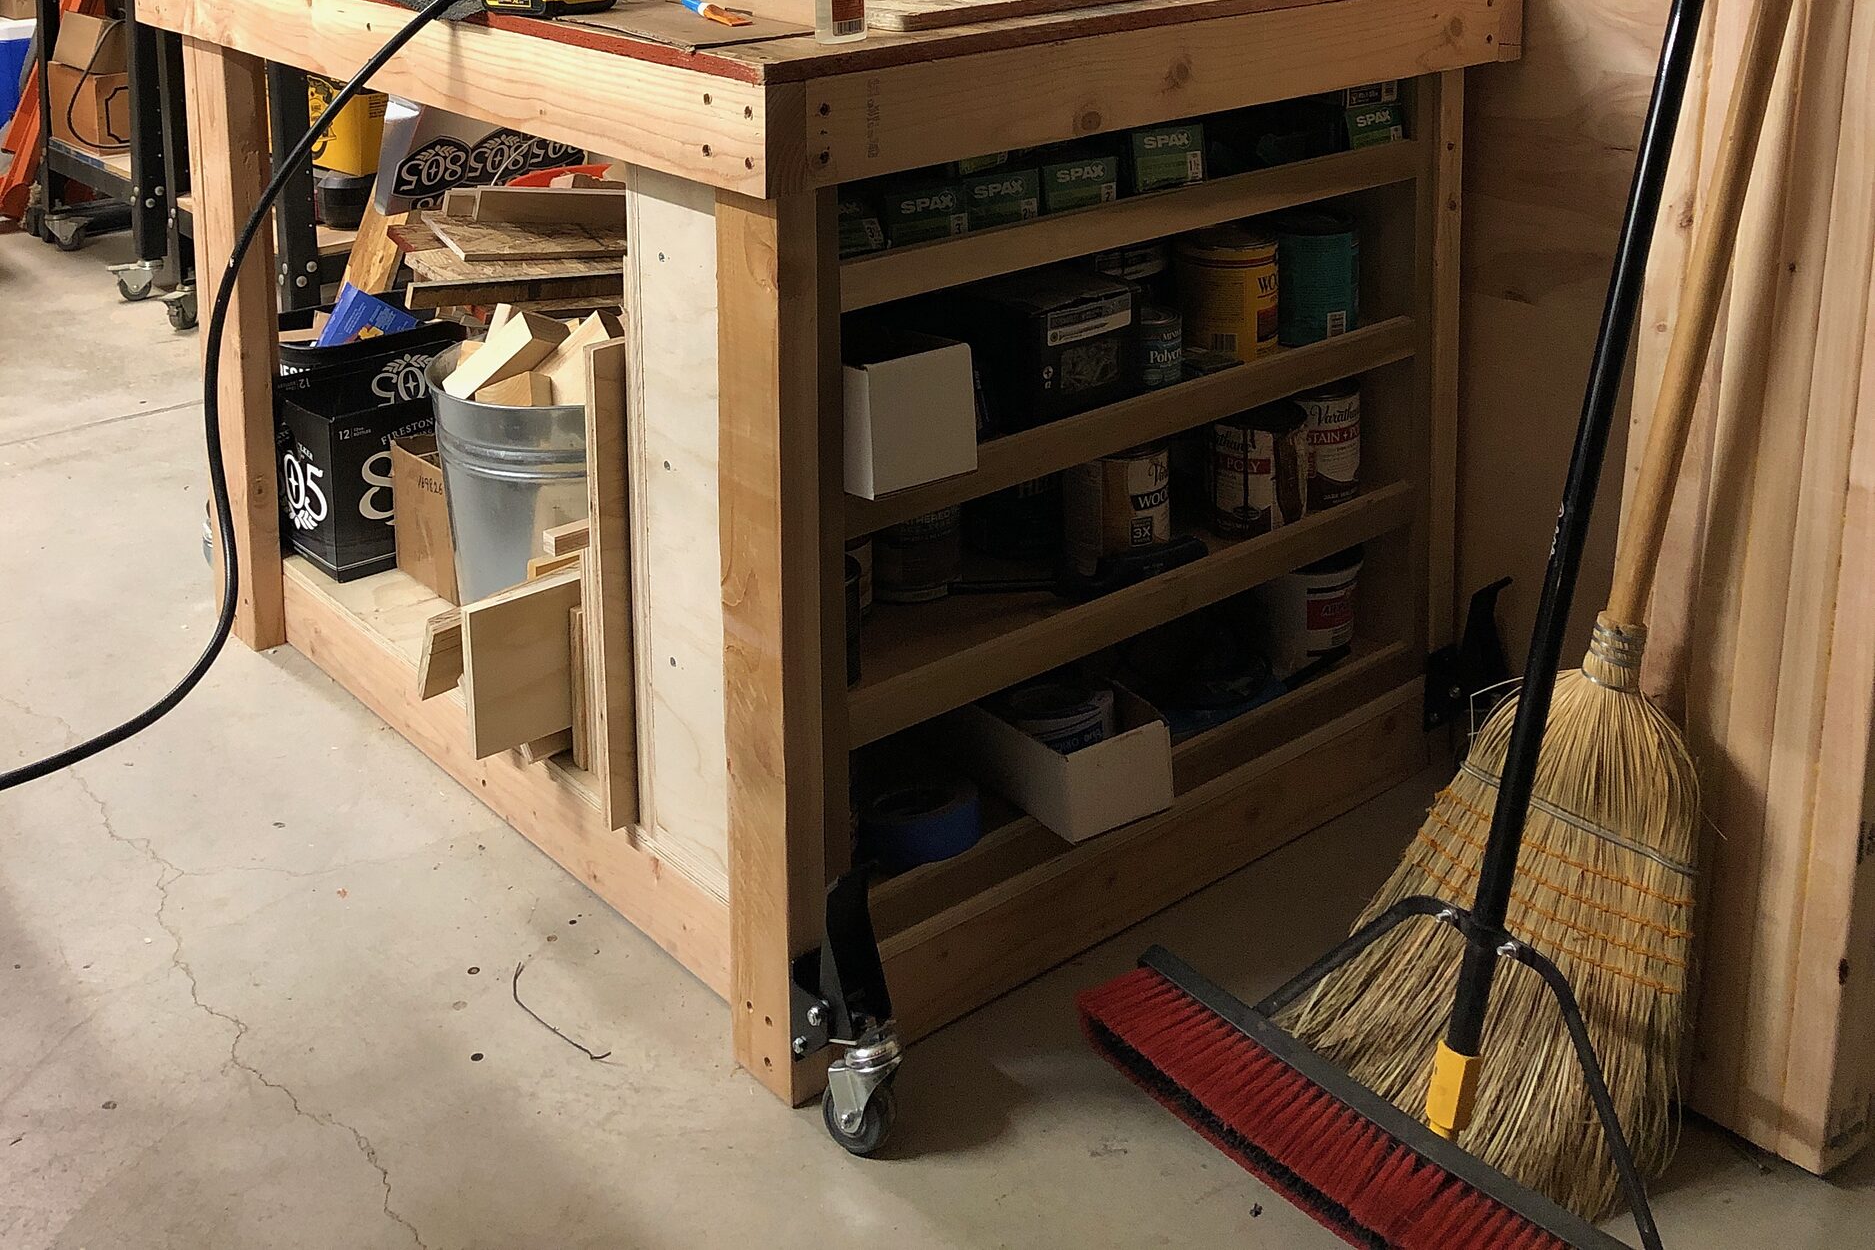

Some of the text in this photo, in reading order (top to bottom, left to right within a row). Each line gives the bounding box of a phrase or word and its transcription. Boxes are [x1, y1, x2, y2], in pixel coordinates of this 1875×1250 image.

[1355, 108, 1392, 129] SPAX
[1142, 129, 1190, 150] SPAX
[401, 150, 468, 191] 805
[469, 140, 530, 178] 805
[1055, 160, 1106, 184] SPAX
[973, 177, 1025, 200] SPAX
[900, 191, 956, 215] SPAX
[1257, 274, 1278, 294] WO
[370, 366, 428, 408] 05
[339, 430, 350, 441] 12
[381, 417, 435, 446] FIRESTON
[1226, 457, 1261, 473] POY
[283, 452, 329, 522] 05
[1137, 489, 1169, 509] WOO
[1132, 526, 1152, 540] 3X
